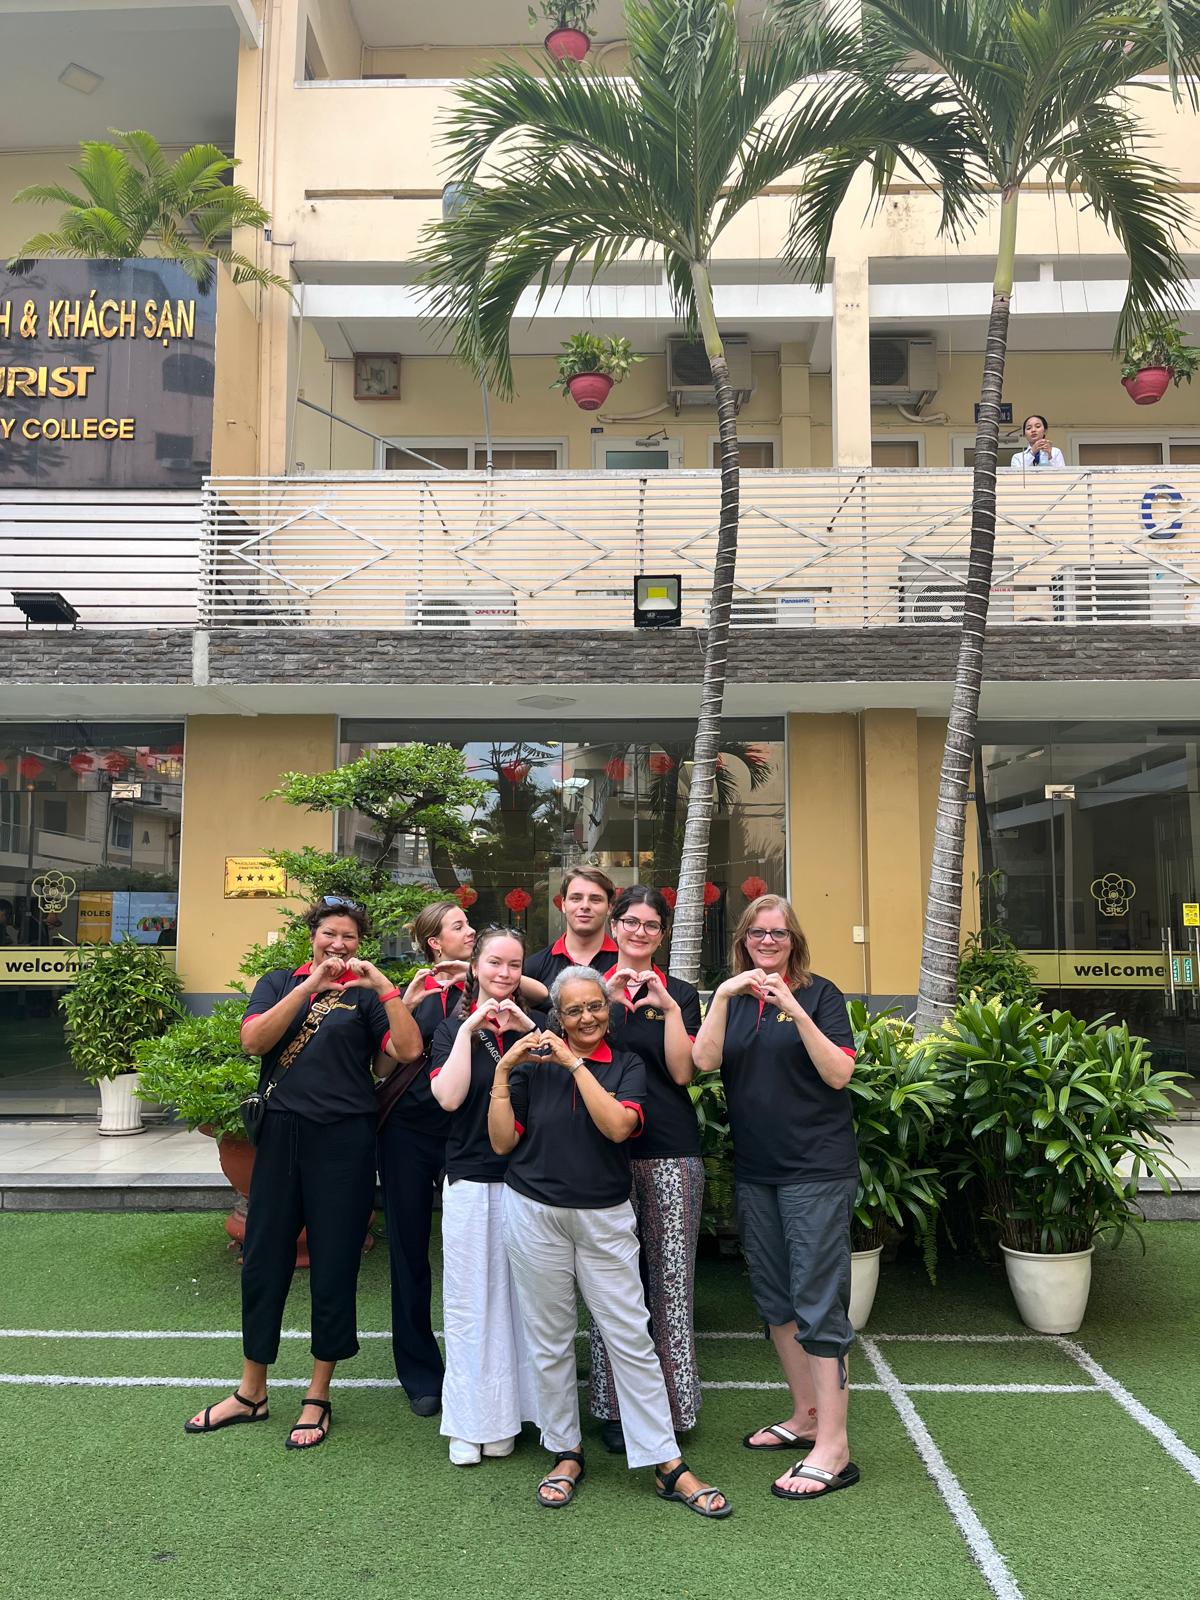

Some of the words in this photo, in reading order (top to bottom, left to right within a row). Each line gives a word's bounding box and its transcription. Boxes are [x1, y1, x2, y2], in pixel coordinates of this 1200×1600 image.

[20, 299, 38, 338] &
[48, 289, 137, 339] KHÁCH
[143, 300, 196, 348] SẠN
[0, 366, 95, 397] RIST
[22, 418, 136, 440] COLLEGE
[1074, 962, 1166, 977] welcome
